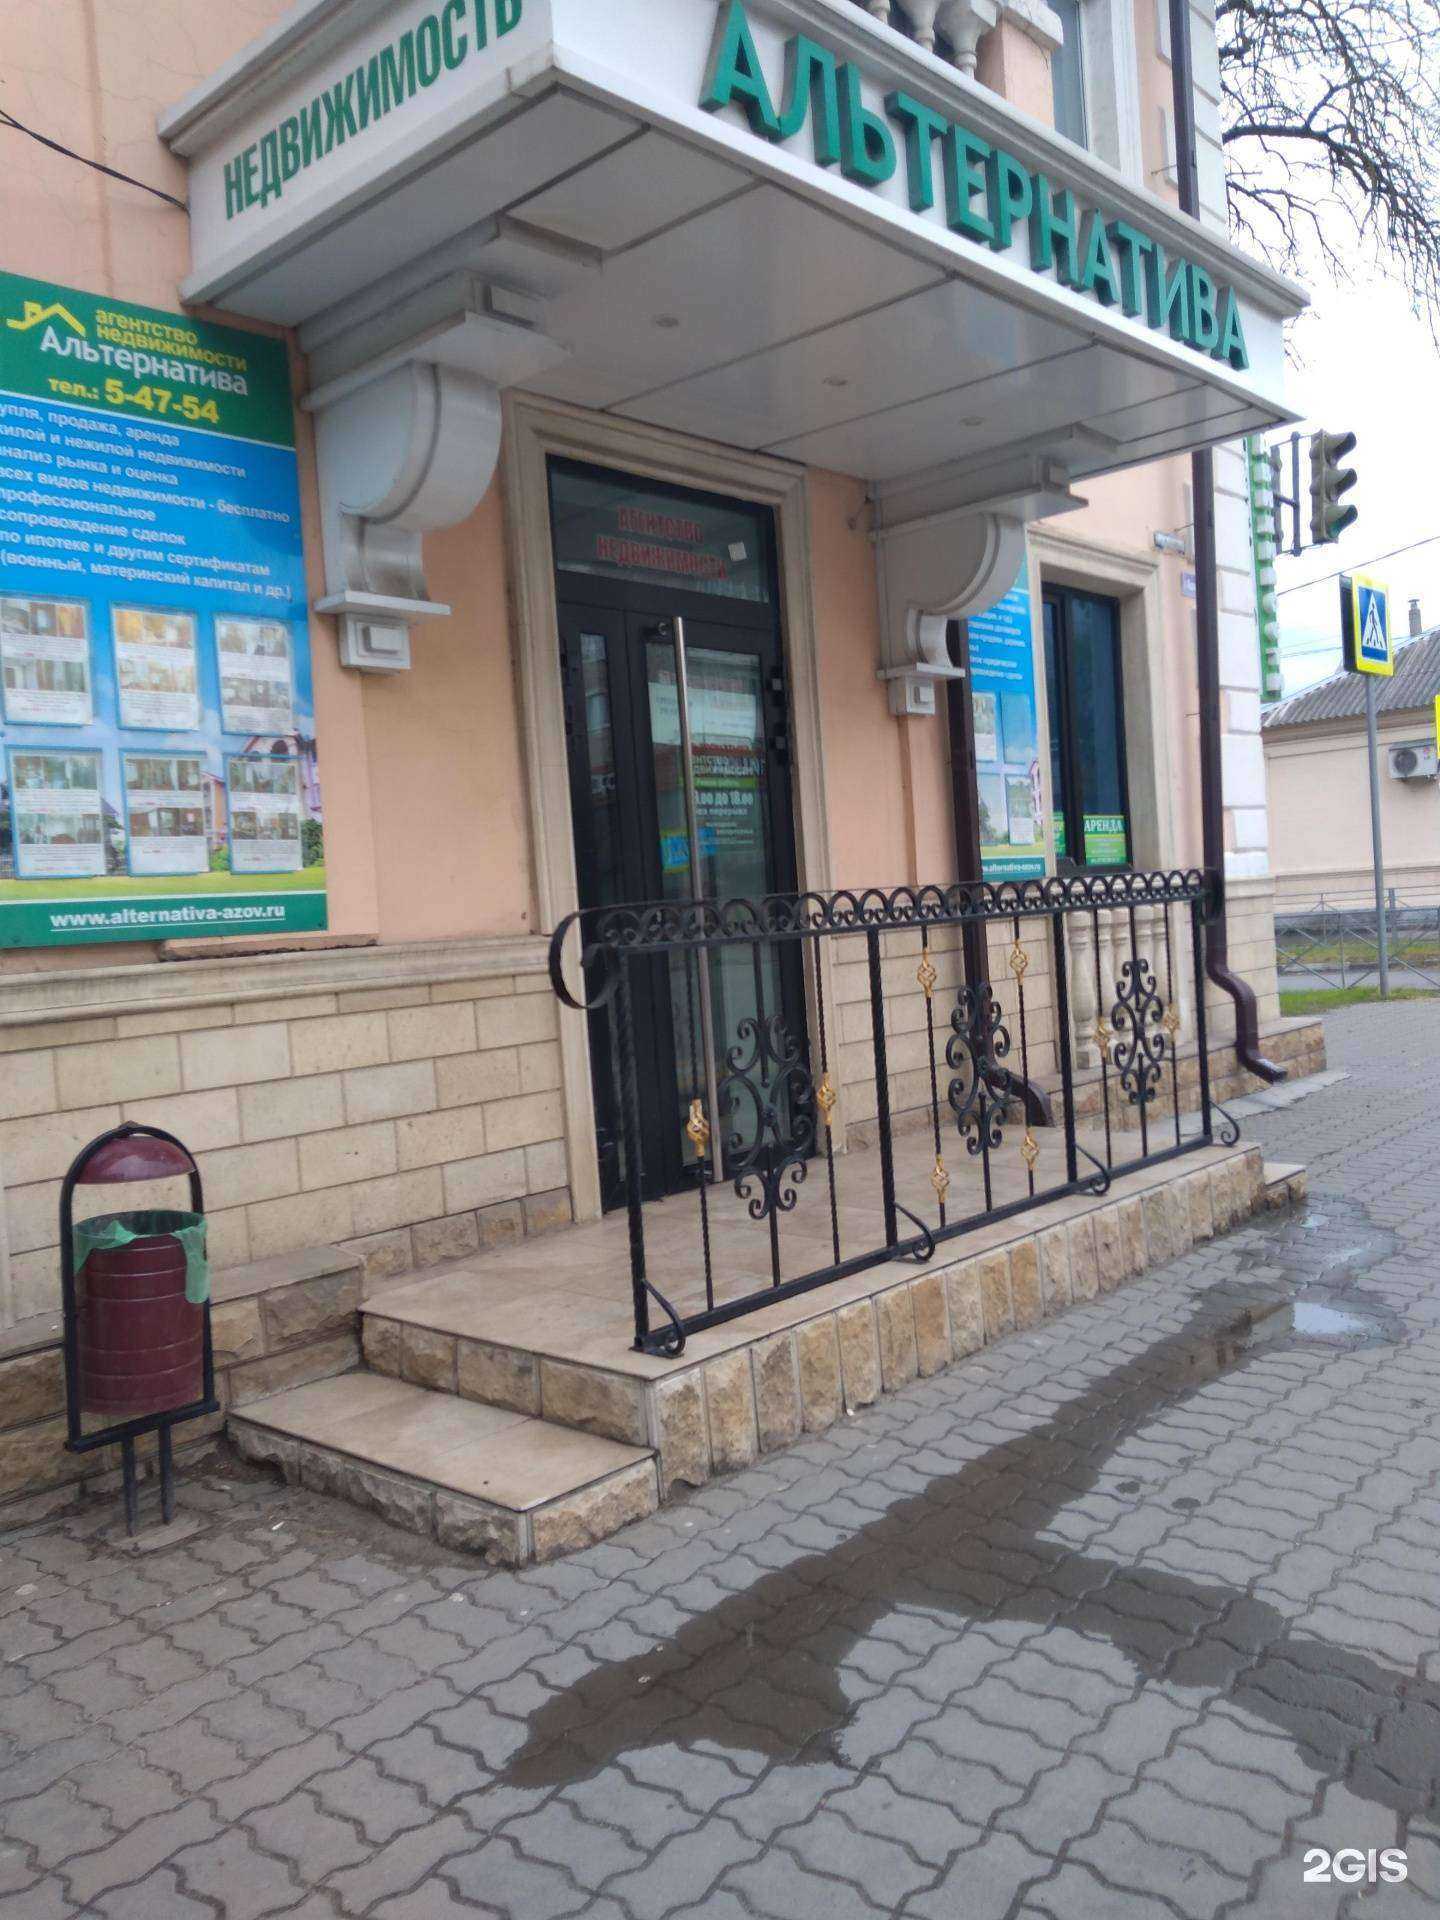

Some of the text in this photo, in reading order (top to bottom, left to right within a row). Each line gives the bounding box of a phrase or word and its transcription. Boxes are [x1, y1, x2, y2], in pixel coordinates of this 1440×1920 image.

[223, 0, 522, 220] НЕДВИЖИМОСТЬ
[701, 0, 1248, 371] АЛЬТЕРНАТИВА
[95, 309, 199, 344] агентство
[97, 325, 248, 372] недвижимости
[40, 325, 248, 395] Альтернатива
[48, 377, 220, 424] тел.: 5-47-54
[0, 404, 180, 447] упля, продажа, аренда
[50, 433, 61, 445] и
[65, 435, 134, 459] нежилой
[138, 449, 247, 479] недвижимости
[56, 454, 109, 475] рынка
[111, 464, 122, 476] и
[125, 467, 178, 487] оценка
[37, 472, 90, 492] видов
[93, 481, 206, 511] недвижимости
[216, 498, 290, 524] бесплатно
[25, 533, 90, 553] ипотеке
[94, 543, 105, 555] и
[132, 526, 187, 547] сделок
[1084, 819, 1125, 835] АРЕНДА
[50, 906, 285, 928] www.alternativa-azov.ru
